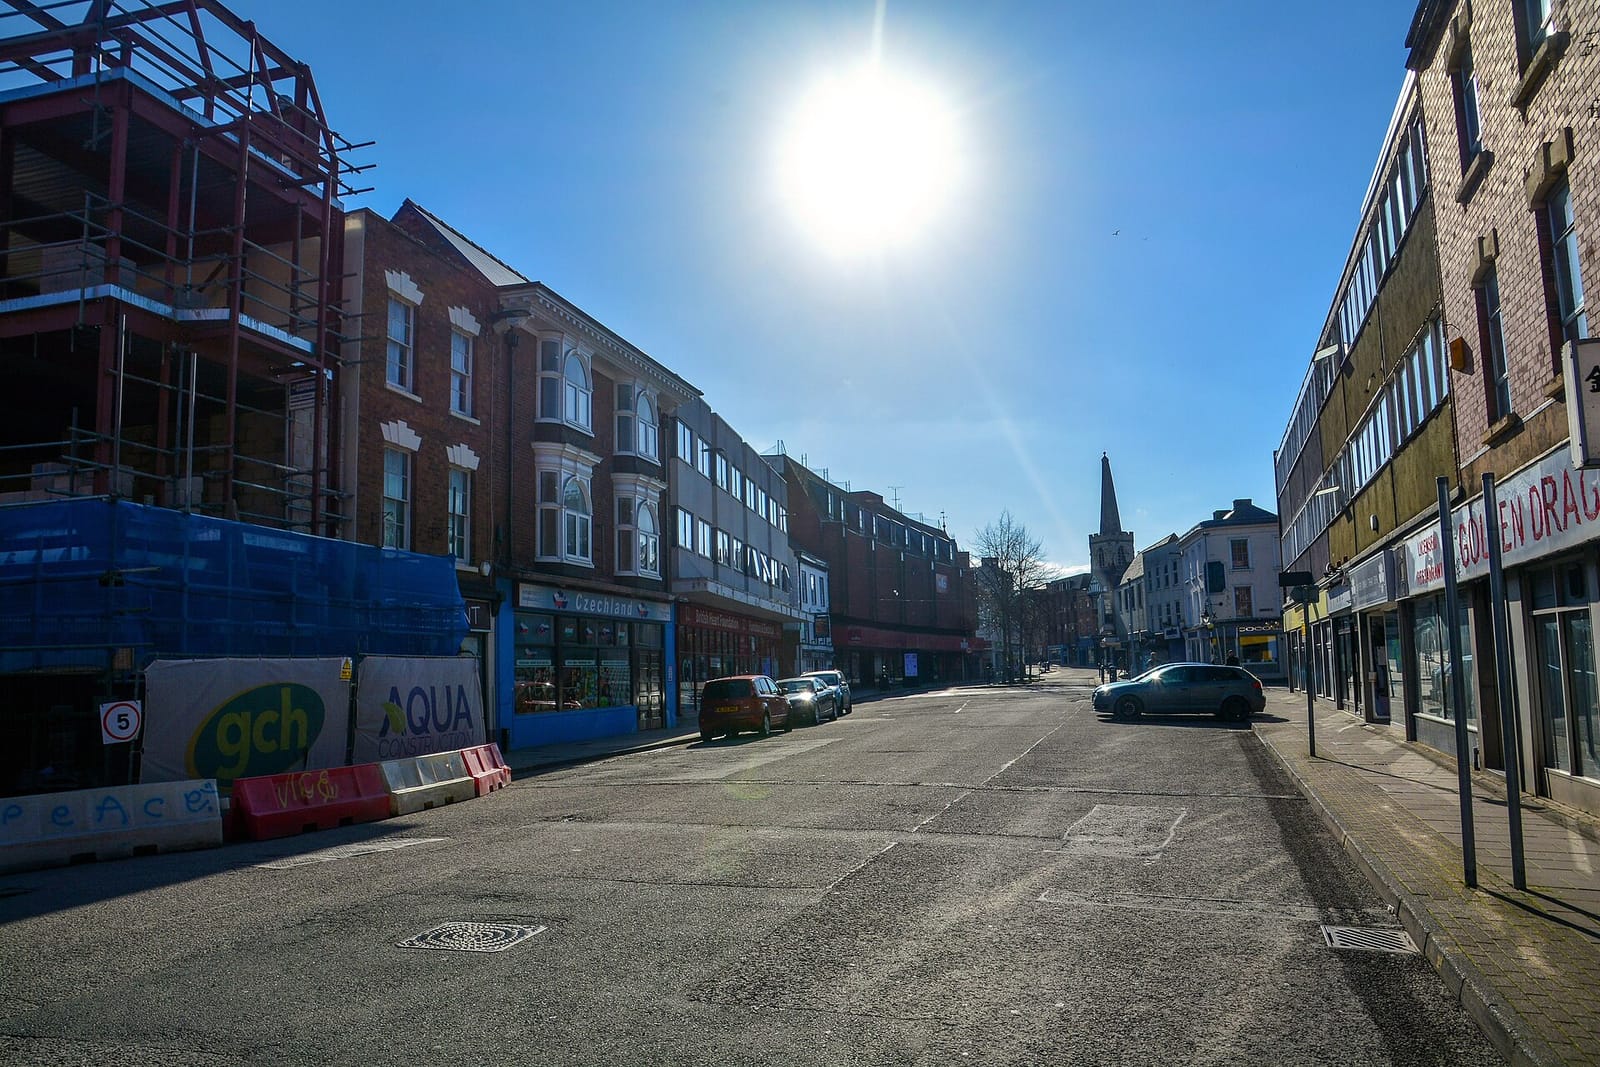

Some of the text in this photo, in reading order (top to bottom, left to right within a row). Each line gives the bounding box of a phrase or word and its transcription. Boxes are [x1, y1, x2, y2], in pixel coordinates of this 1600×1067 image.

[1459, 496, 1525, 569] GOLEN
[575, 594, 633, 617] Czechland
[117, 713, 130, 730] 5
[379, 685, 473, 738] AQUA
[216, 687, 308, 783] gch
[379, 730, 473, 759] CONSTRUCTION
